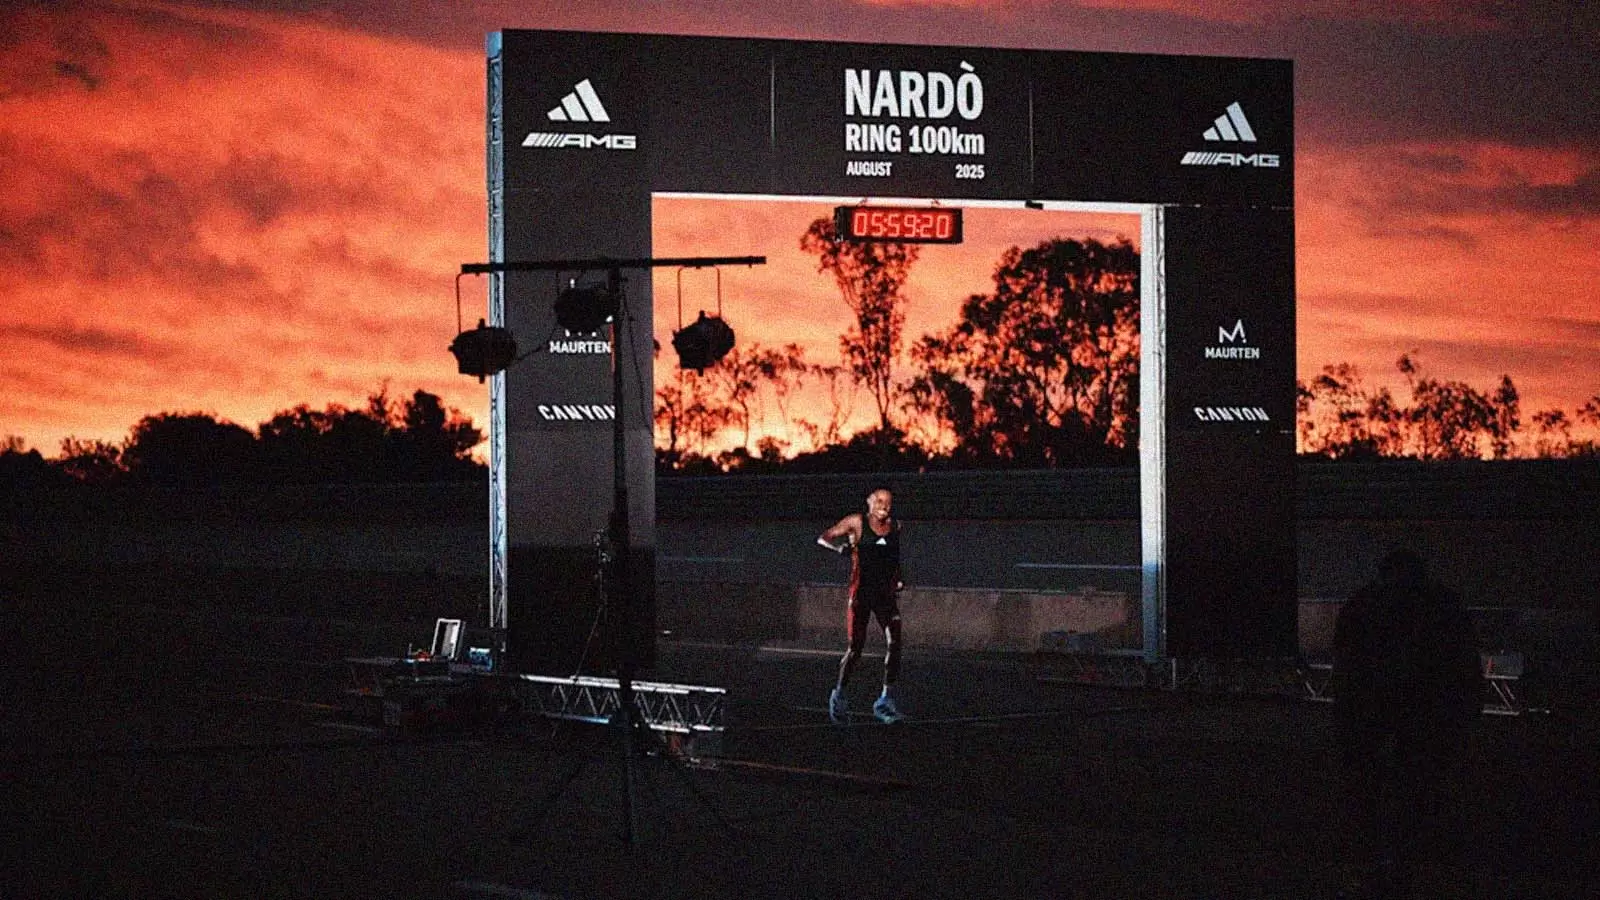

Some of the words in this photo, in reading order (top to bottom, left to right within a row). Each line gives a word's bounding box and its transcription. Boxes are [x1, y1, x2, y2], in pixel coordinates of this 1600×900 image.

[845, 60, 984, 120] NARDÒ
[845, 123, 901, 152] RING
[908, 125, 985, 155] 100km
[846, 161, 892, 176] AUGUST
[955, 164, 985, 179] 2025
[853, 212, 950, 238] 05:59:20
[549, 341, 612, 353] MAURTEN
[1205, 347, 1260, 359] MAURTEN
[1194, 407, 1270, 421] CANYON
